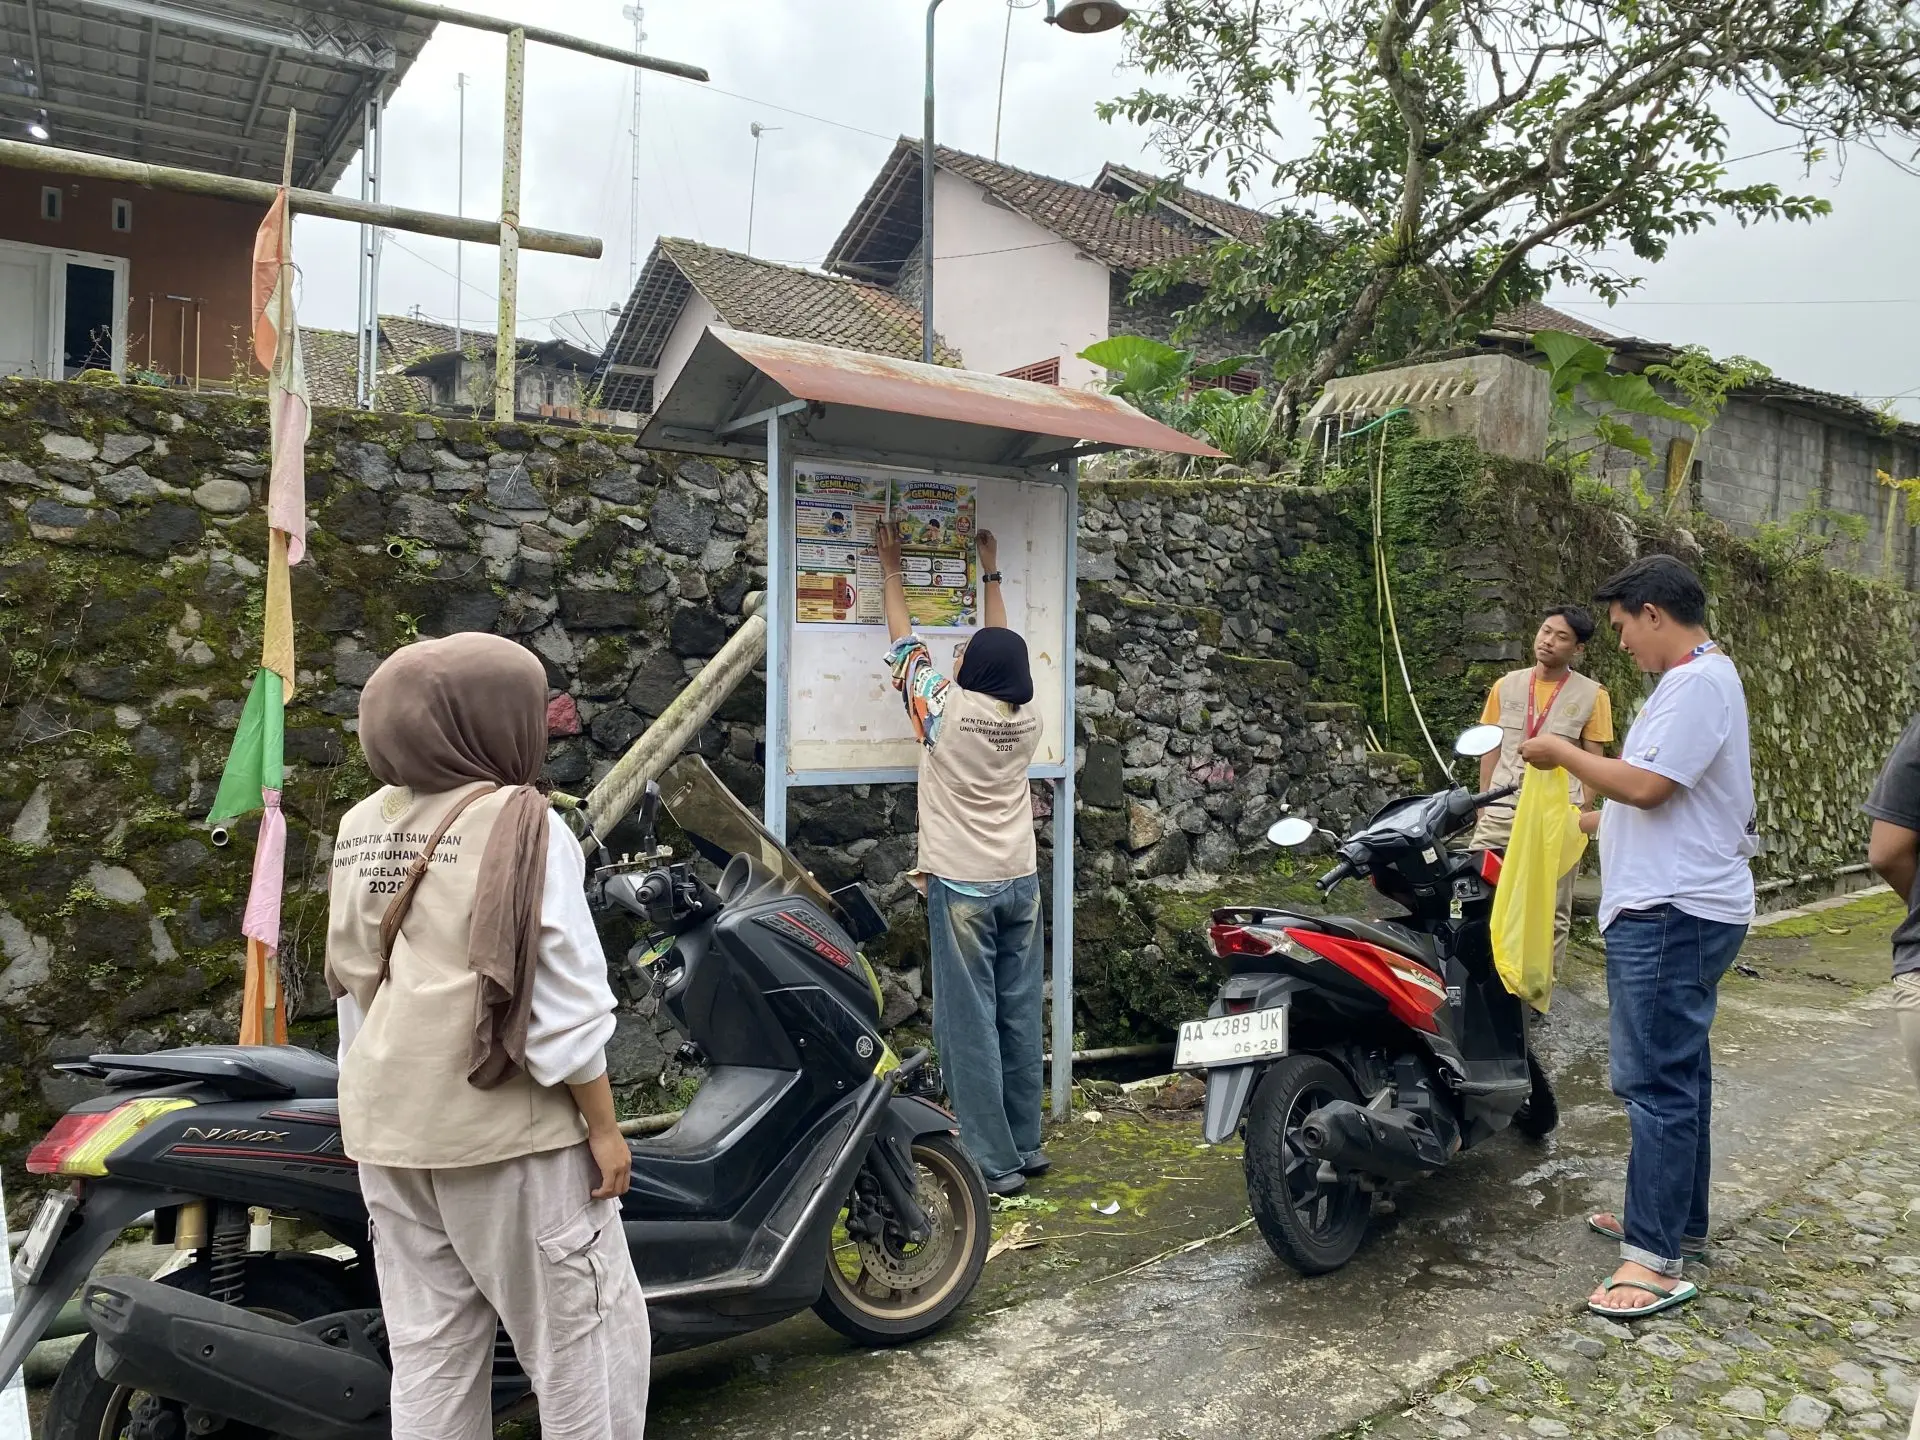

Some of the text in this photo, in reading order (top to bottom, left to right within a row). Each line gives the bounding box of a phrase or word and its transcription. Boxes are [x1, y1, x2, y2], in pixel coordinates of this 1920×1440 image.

[819, 480, 860, 490] GEMILANG
[911, 490, 954, 501] GEMILANG
[976, 719, 1003, 728] TEMATIK
[959, 726, 1000, 736] UNIVERSITAS
[336, 839, 352, 851] KKN
[359, 867, 410, 878] MAGELAN
[815, 943, 848, 966] 155
[1184, 1012, 1279, 1041] AA 4389 UK
[181, 1127, 291, 1143] NMAX
